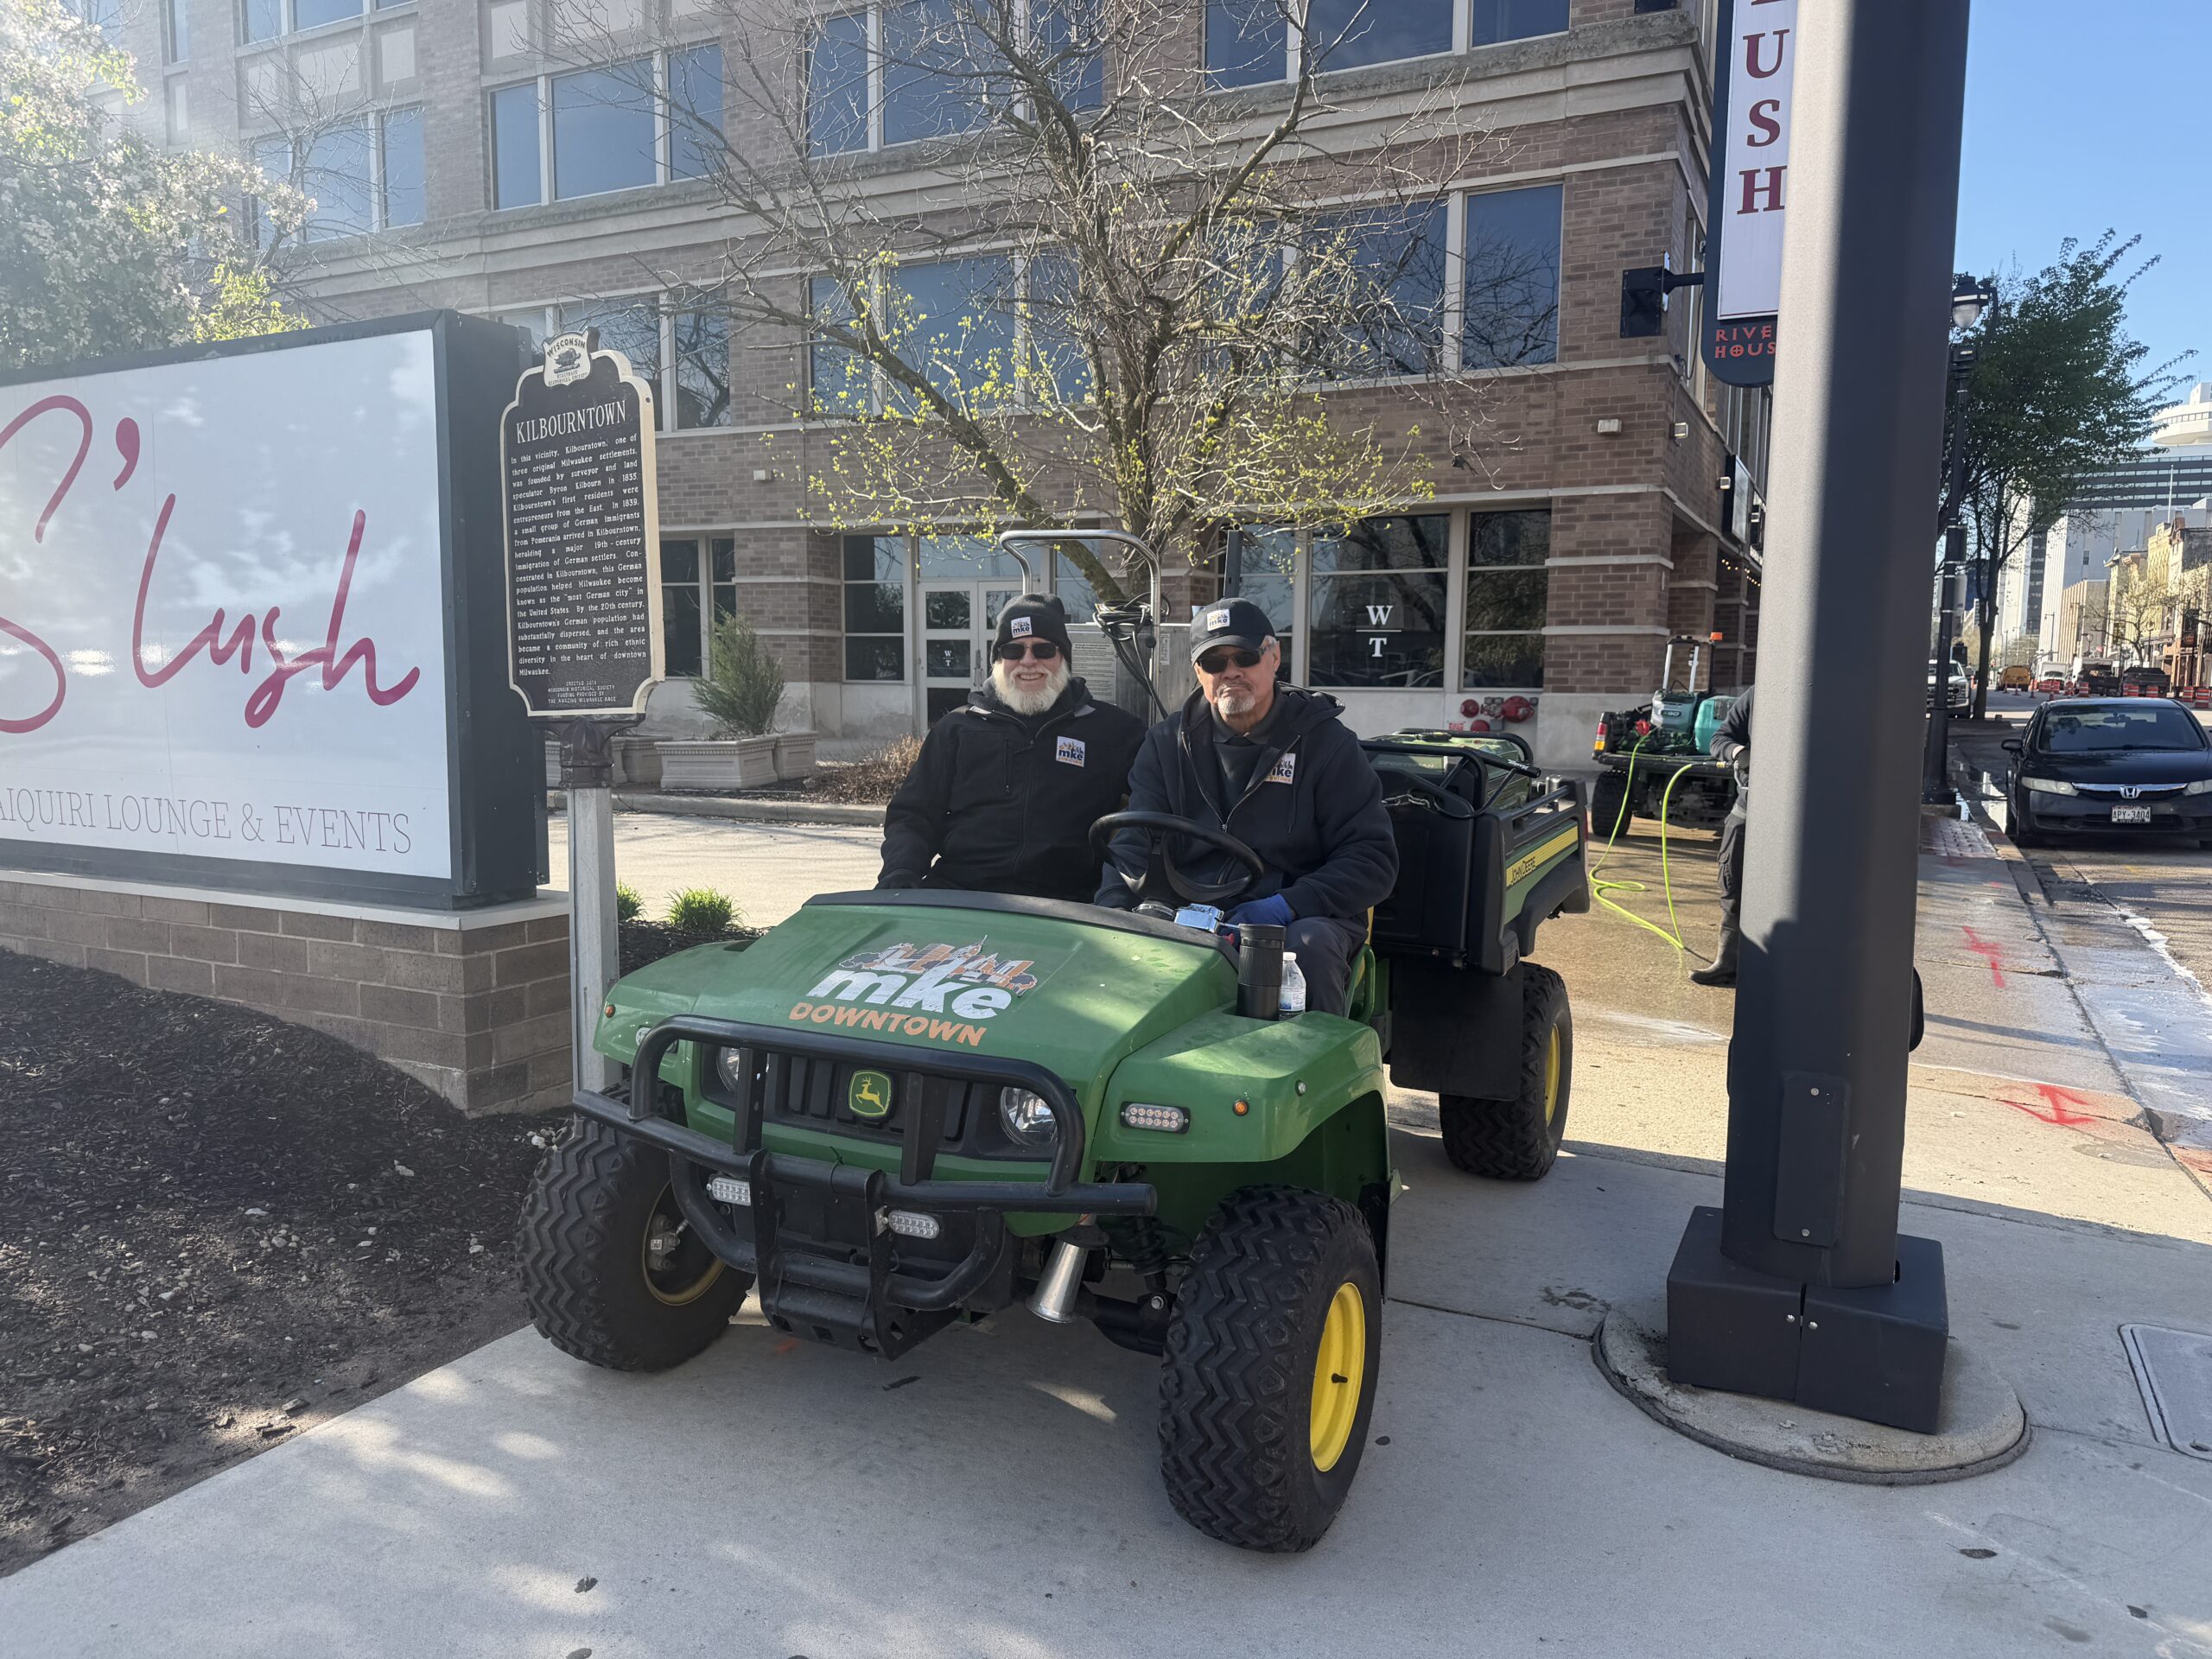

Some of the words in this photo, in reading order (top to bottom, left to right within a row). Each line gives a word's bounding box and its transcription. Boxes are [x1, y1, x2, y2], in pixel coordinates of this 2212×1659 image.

[1737, 0, 1789, 214] USH
[1715, 325, 1771, 341] RIVE
[546, 338, 586, 357] WISCONSIN
[1714, 341, 1777, 359] HOUS
[516, 400, 626, 444] KILBOURNTOWN
[532, 461, 555, 472] original
[562, 456, 592, 467] Milwaukee
[528, 474, 550, 485] founded
[571, 467, 598, 477] surveyor
[606, 463, 616, 472] and
[624, 460, 637, 468] land
[513, 490, 543, 500] speculator
[550, 486, 567, 494] Byron
[575, 480, 601, 489] Kilbourn
[563, 495, 575, 504] first
[584, 491, 613, 500] residents
[513, 512, 553, 524] entrepreneurs
[522, 525, 536, 534] small
[541, 524, 558, 532] group
[605, 512, 639, 522] immigrants
[531, 534, 560, 544] Pomerania
[563, 531, 584, 540] arrived
[515, 550, 541, 558] heralding
[566, 543, 583, 552] major
[516, 561, 550, 570] immigration
[516, 573, 543, 582] centrated
[517, 585, 547, 594] population
[579, 578, 611, 588] Milwaukee
[593, 614, 626, 625] population
[1209, 618, 1228, 626] mke
[1365, 605, 1393, 626] W
[518, 632, 555, 640] substantially
[1013, 625, 1030, 633] mke
[626, 638, 645, 646] ethnic
[1369, 638, 1387, 658] T
[1058, 748, 1084, 760] mke
[104, 794, 232, 839] LOUNGE
[241, 803, 265, 842] &
[273, 805, 411, 854] EVENTS
[1510, 866, 1522, 884] JOHN
[1522, 856, 1535, 875] DEERE
[805, 959, 1012, 1020] mke
[788, 1001, 987, 1046] DOWNTOWN
